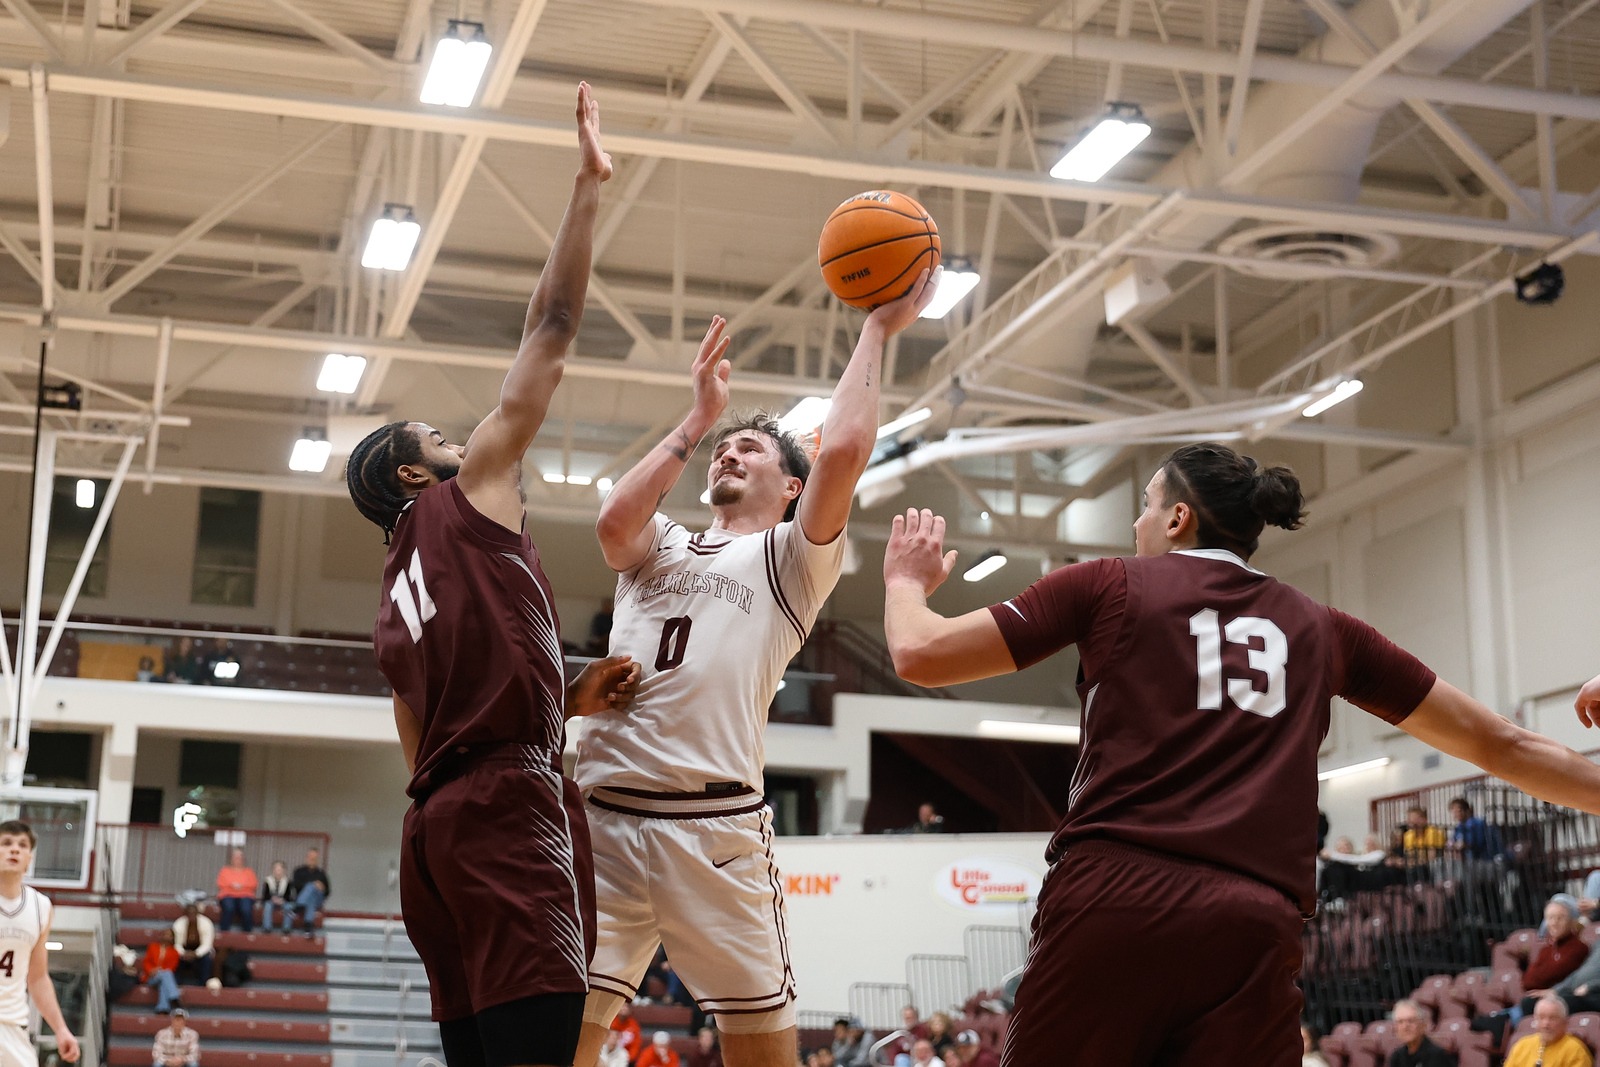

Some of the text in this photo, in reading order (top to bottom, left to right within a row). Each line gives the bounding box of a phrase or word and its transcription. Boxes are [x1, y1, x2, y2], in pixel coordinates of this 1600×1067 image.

[389, 546, 438, 645] 11
[654, 614, 693, 672] 0
[1188, 607, 1289, 719] 13
[951, 867, 991, 889] Little
